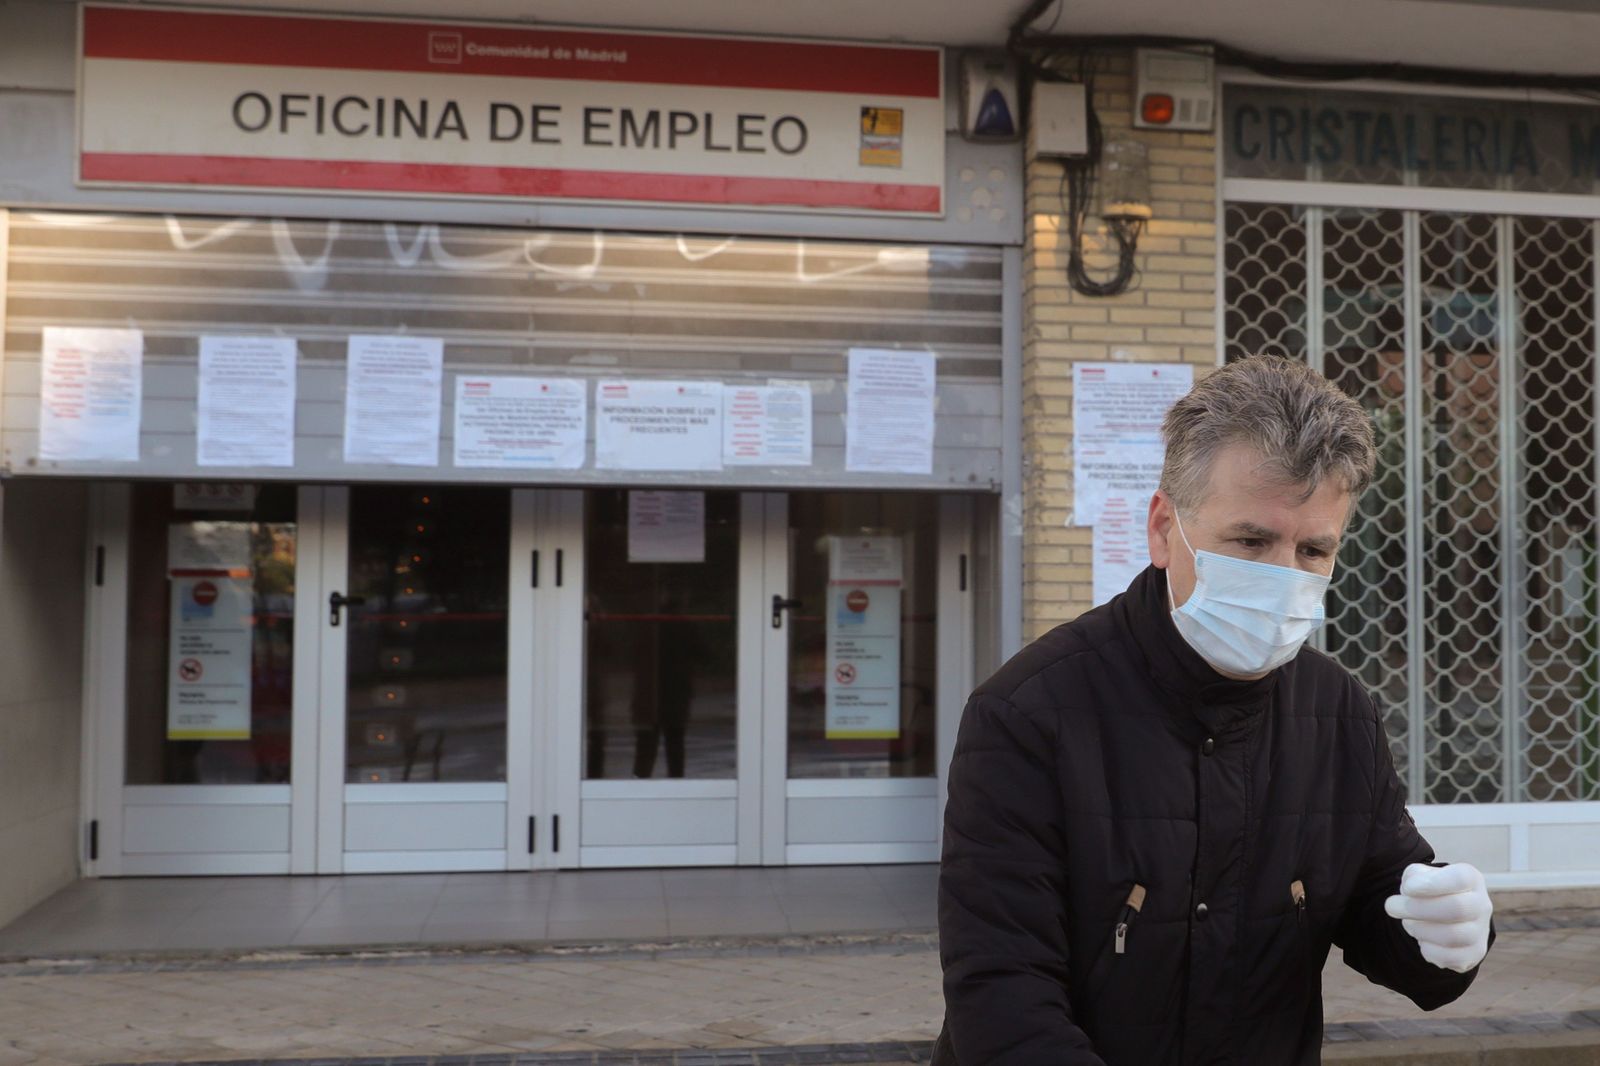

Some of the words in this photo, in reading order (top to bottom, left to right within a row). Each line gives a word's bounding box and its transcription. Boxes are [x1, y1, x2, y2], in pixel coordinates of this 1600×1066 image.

[466, 42, 549, 59] Comunidad
[553, 47, 572, 60] de
[575, 47, 627, 62] Madrid
[232, 91, 469, 141] OFICINA
[489, 103, 562, 145] DE
[582, 106, 809, 155] EMPLEO
[1232, 104, 1540, 177] CRISTALERIA
